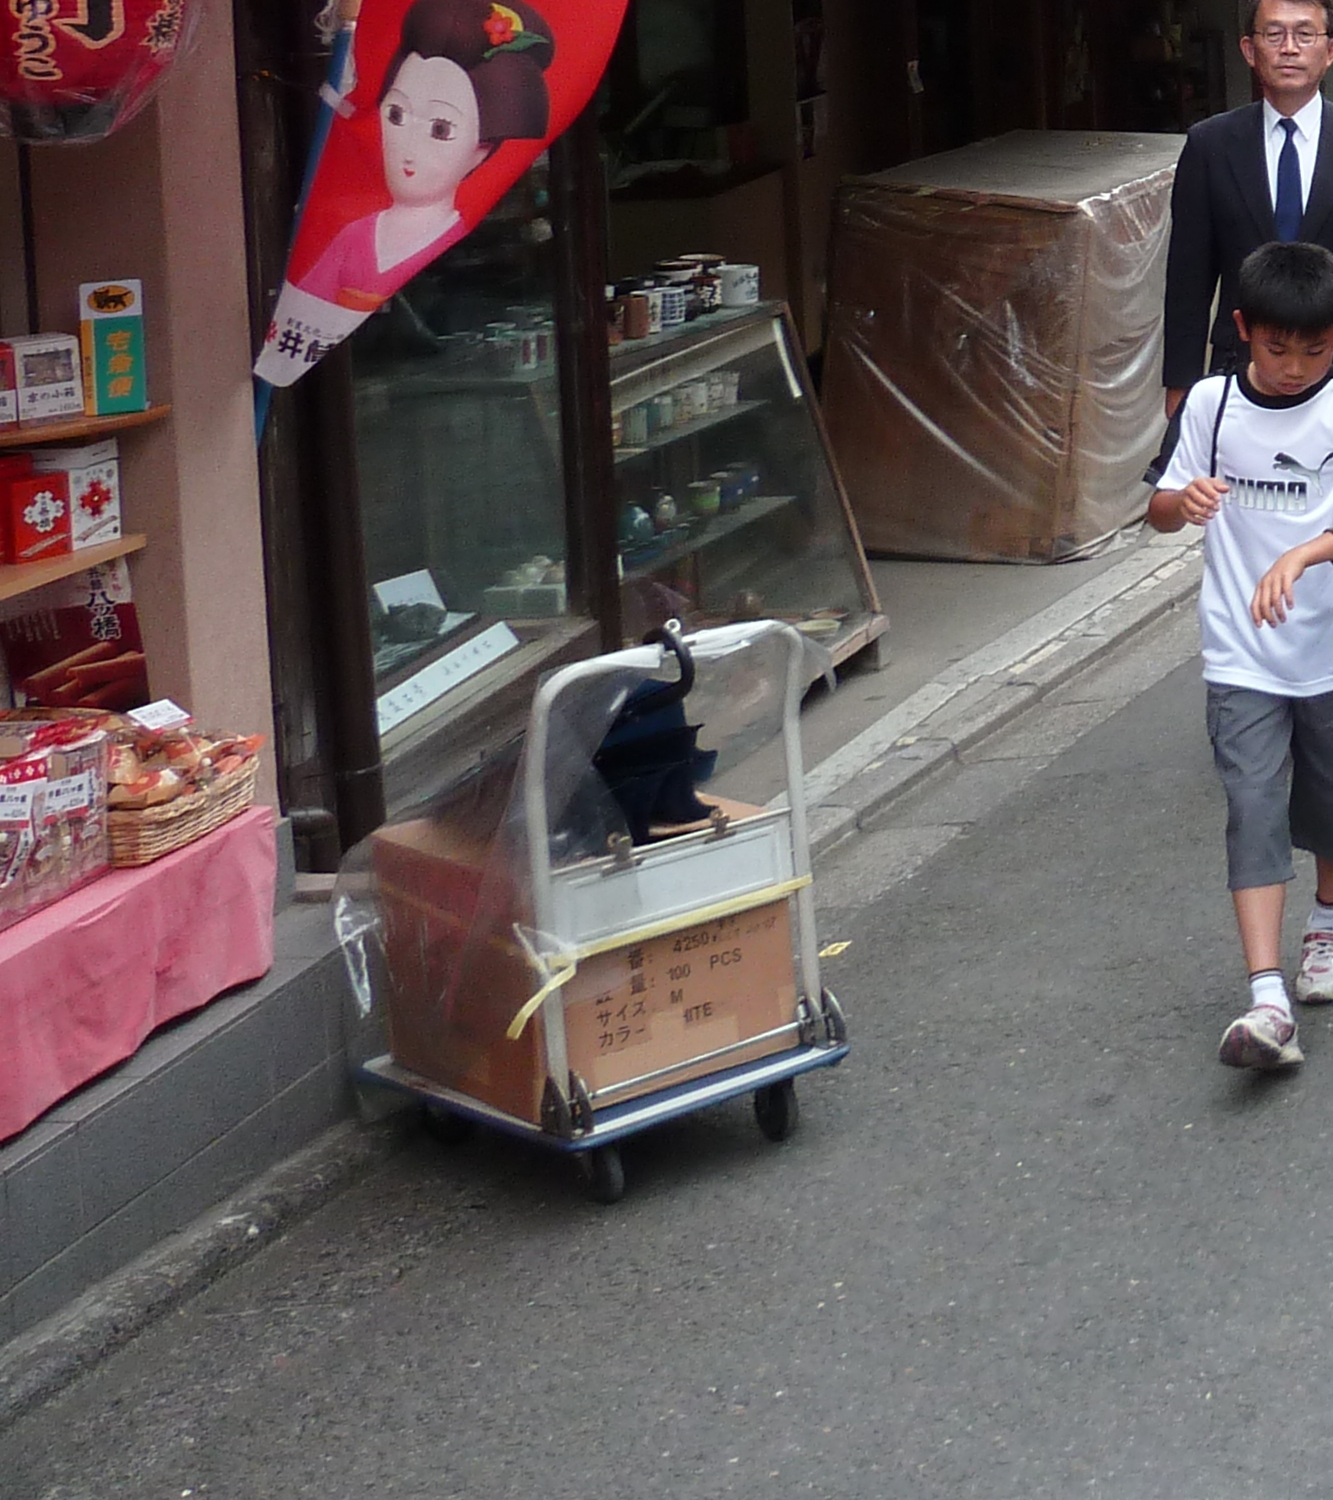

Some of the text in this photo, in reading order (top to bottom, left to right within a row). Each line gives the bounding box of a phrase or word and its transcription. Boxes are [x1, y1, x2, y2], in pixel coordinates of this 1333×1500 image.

[1224, 474, 1307, 512] PUMA
[666, 963, 691, 981] 100
[710, 947, 743, 971] PCS
[596, 988, 684, 1028] サイズ M
[598, 1025, 646, 1049] カラー
